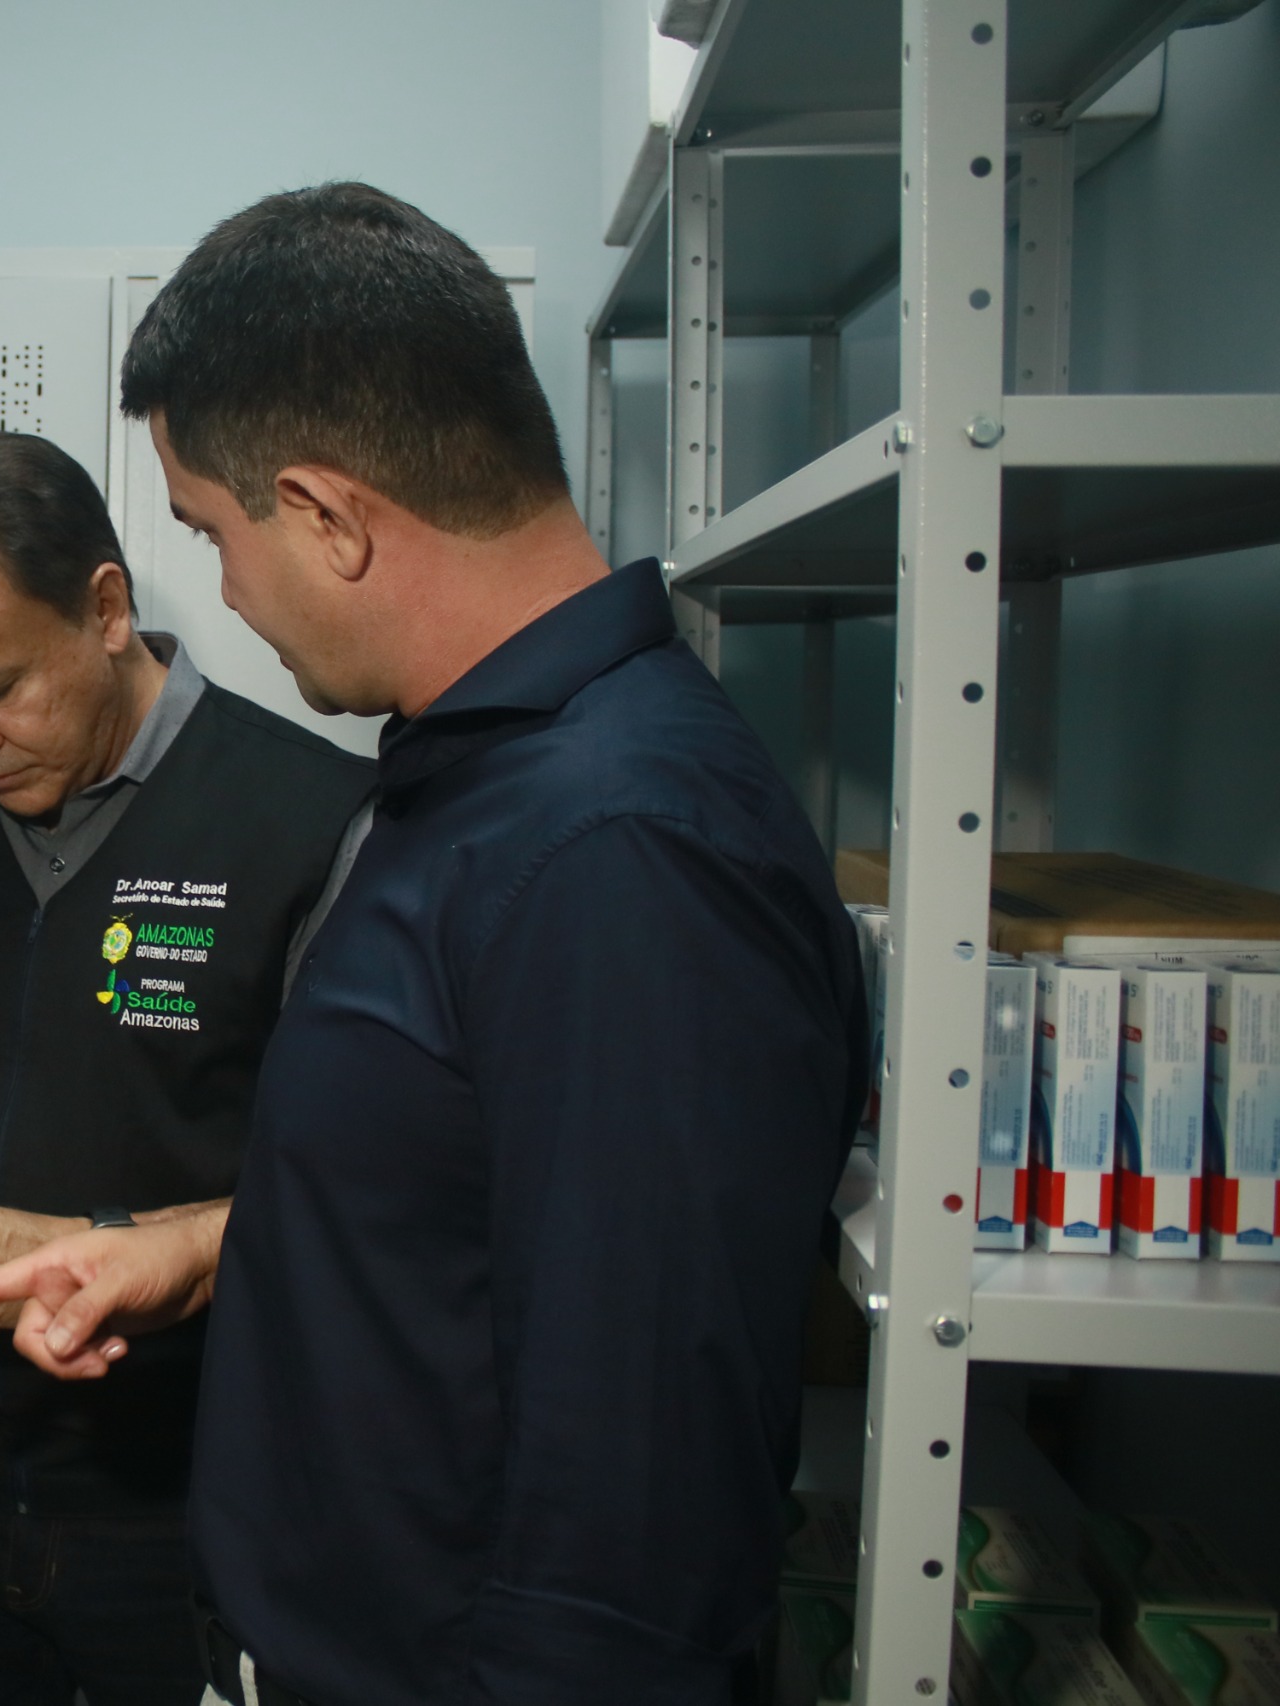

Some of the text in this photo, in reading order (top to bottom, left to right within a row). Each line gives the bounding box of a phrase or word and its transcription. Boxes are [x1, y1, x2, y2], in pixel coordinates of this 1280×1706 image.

[182, 881, 227, 895] Samad
[150, 895, 161, 903] de
[162, 895, 190, 906] Estado
[191, 897, 201, 906] de
[201, 897, 226, 909] Saúde
[136, 923, 215, 947] AMAZONAS
[141, 978, 185, 993] PROGRAMA
[128, 991, 196, 1013] Saúde
[120, 1008, 200, 1031] Amazonas
